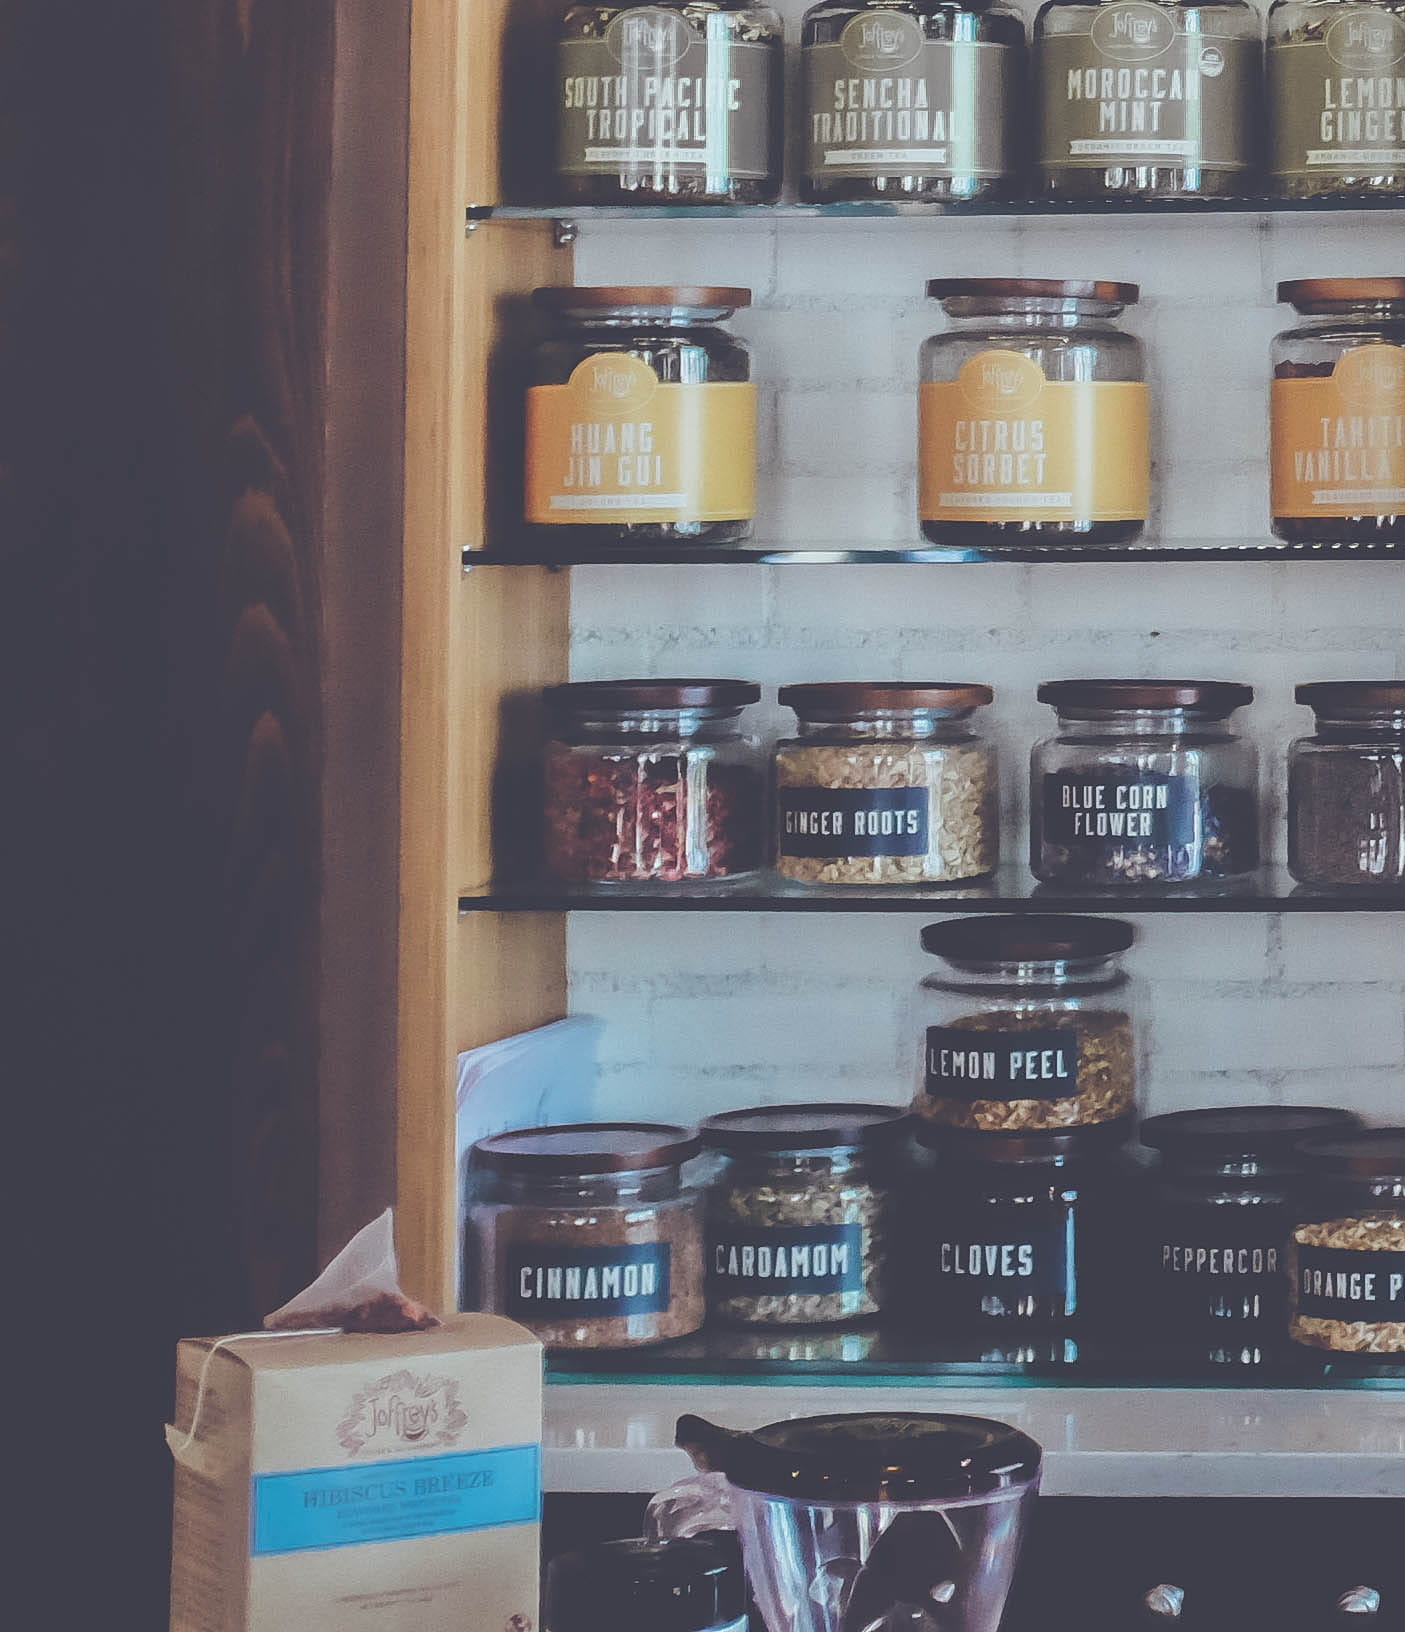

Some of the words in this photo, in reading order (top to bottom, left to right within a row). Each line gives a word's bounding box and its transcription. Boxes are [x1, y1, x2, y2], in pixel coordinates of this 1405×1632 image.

[564, 76, 627, 109] SOUTH
[645, 76, 741, 111] PACIC
[834, 79, 928, 109] SENCHA
[586, 110, 706, 142] TROPICAL
[1099, 101, 1162, 132] MINT
[954, 419, 1044, 453] CITRUS
[563, 456, 603, 487] JIN
[952, 452, 1048, 485] SORBET
[1295, 447, 1392, 483] VANILLA
[1062, 785, 1105, 809] BLUE
[1116, 784, 1168, 809] CORN
[785, 810, 842, 835] GINGER
[853, 809, 919, 835] ROOTS
[1074, 812, 1152, 837] FLOWER
[930, 1049, 996, 1080] LEMON
[1009, 1050, 1068, 1080] PEEL
[715, 1242, 849, 1278] CARDAMOM
[941, 1243, 1033, 1276] CLOVES
[1162, 1245, 1277, 1274] PEPPERCOR
[520, 1263, 656, 1300] CINNAMON
[1303, 1268, 1376, 1301] ORANGE
[303, 1480, 408, 1509] HIBISCUS
